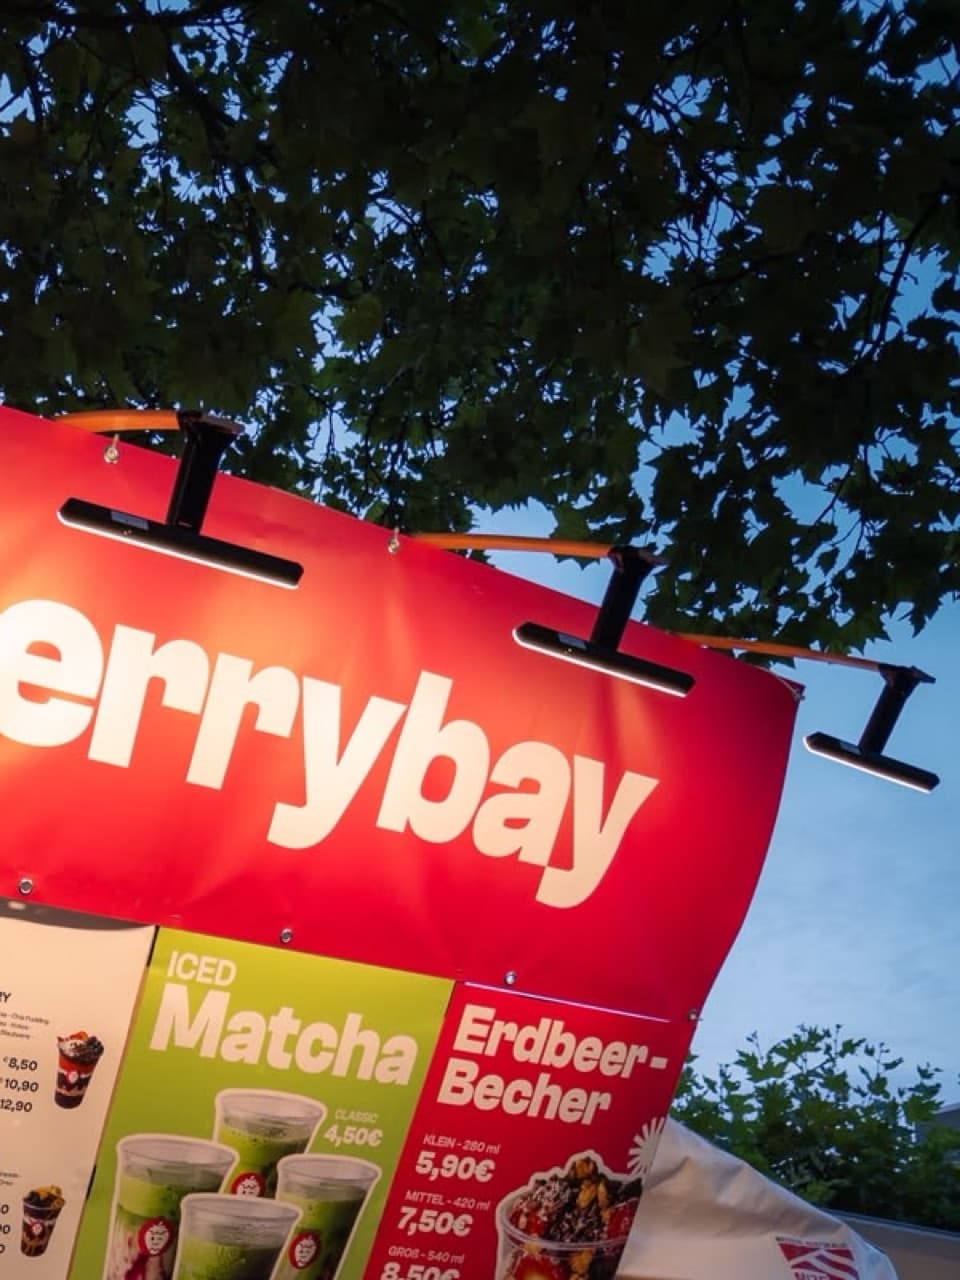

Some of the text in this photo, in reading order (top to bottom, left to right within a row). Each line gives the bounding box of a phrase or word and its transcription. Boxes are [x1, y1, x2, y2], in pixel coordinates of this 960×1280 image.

[166, 951, 237, 986] ICED
[149, 982, 418, 1085] Matcha
[453, 1004, 668, 1079] Erdbeer-
[436, 1057, 612, 1125] Becher
[324, 1123, 383, 1148] 4,50€
[423, 1133, 455, 1148] KLEIN
[462, 1138, 485, 1152] 280
[487, 1142, 501, 1154] ml
[415, 1151, 496, 1183] 5,90€
[405, 1190, 444, 1206] MITTEL
[452, 1195, 475, 1210] 420
[476, 1198, 490, 1210] ml
[397, 1206, 474, 1237] 7,50€
[426, 1249, 449, 1263] 540
[450, 1251, 465, 1264] ml
